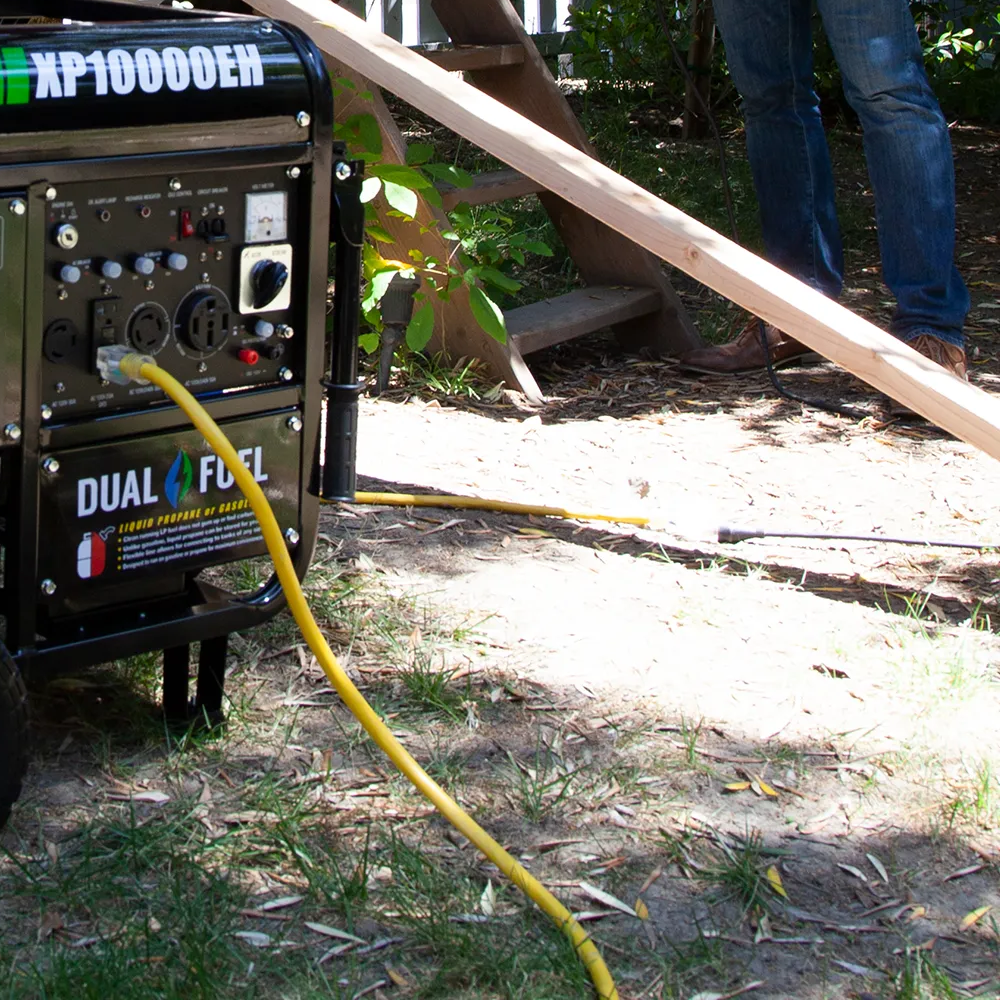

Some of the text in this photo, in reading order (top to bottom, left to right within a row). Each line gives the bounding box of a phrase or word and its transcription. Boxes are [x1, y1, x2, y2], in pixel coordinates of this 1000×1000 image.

[29, 43, 265, 100] XP10000EH
[76, 445, 268, 518] DUAL FUEL
[118, 498, 250, 534] LIQUID PROPANE or GASOL
